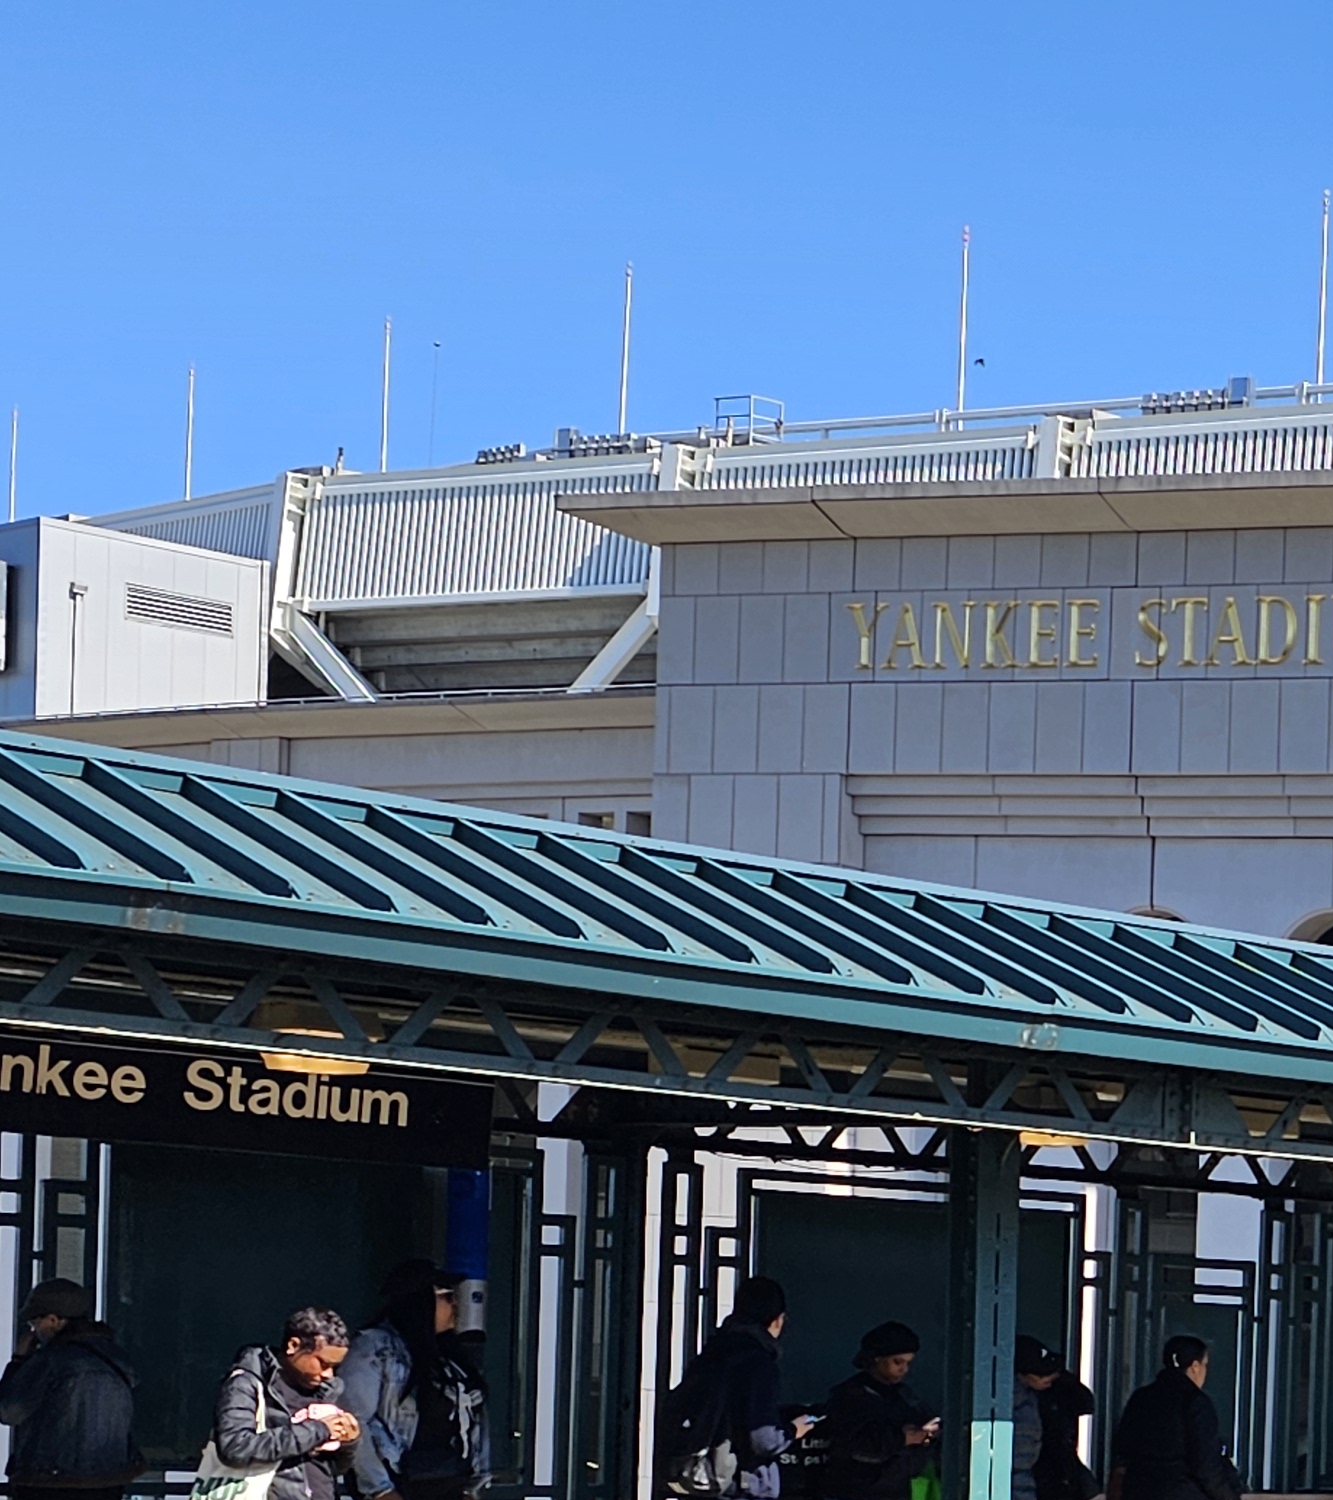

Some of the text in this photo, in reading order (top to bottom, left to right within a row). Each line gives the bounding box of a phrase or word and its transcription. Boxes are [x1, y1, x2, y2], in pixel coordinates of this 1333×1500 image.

[846, 598, 1100, 671] YANKEE
[0, 1044, 410, 1127] nkee Stadium
